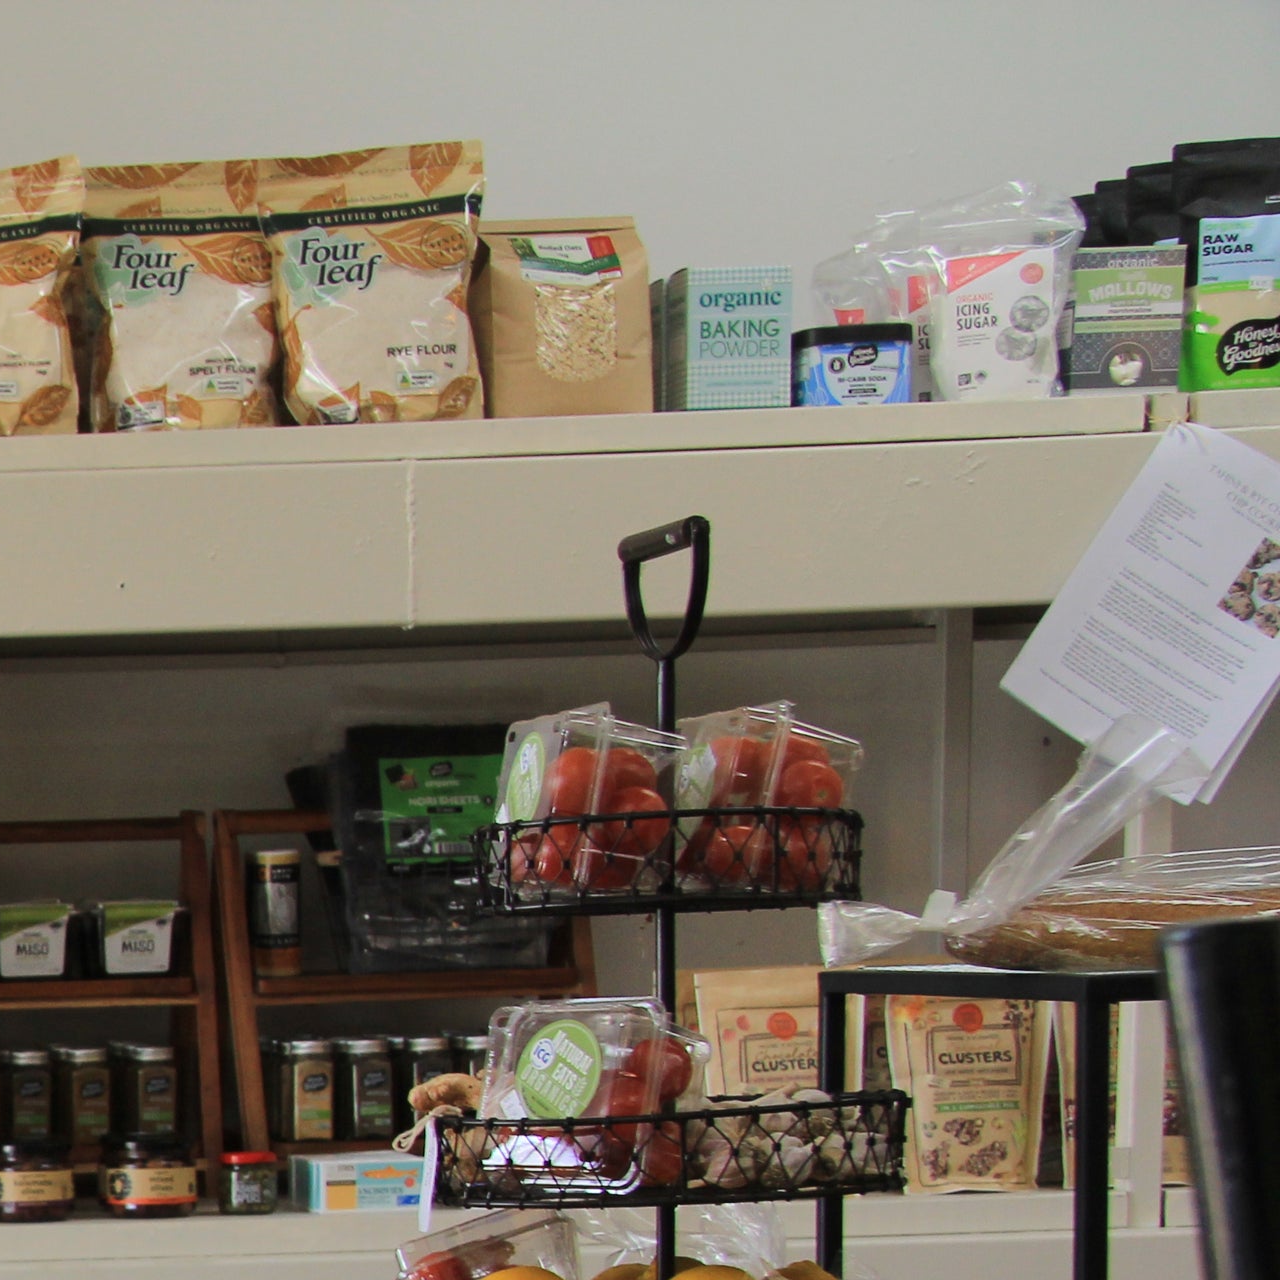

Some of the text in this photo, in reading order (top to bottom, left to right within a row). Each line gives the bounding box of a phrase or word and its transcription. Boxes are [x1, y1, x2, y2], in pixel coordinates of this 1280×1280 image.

[307, 203, 441, 226] CERTIFIED ORGANIC
[123, 222, 191, 232] CERTIFIED
[1203, 233, 1239, 245] RAW
[112, 244, 178, 270] Four
[299, 237, 366, 266] Four
[1203, 243, 1254, 257] SUGAR
[1108, 256, 1159, 269] organic
[130, 264, 195, 296] leaf
[316, 254, 382, 290] leaf
[955, 293, 993, 303] ORGANIC
[1088, 281, 1174, 302] MALLOWS
[699, 290, 782, 312] organic
[956, 303, 990, 316] ICING
[699, 319, 780, 339] BAKING
[957, 316, 998, 331] SUGAR
[387, 343, 457, 358] RYE FLOUR
[699, 339, 780, 359] POWDER
[189, 366, 222, 377] SPELT
[15, 943, 50, 957] MISO
[121, 939, 156, 954] MISO
[533, 1044, 551, 1064] ICG
[553, 1029, 595, 1076] NATURAL
[938, 1050, 1013, 1065] CLUSTERS
[751, 1057, 818, 1073] CLUSTER
[551, 1062, 578, 1091] EATS
[520, 1063, 578, 1118] ORGANICS
